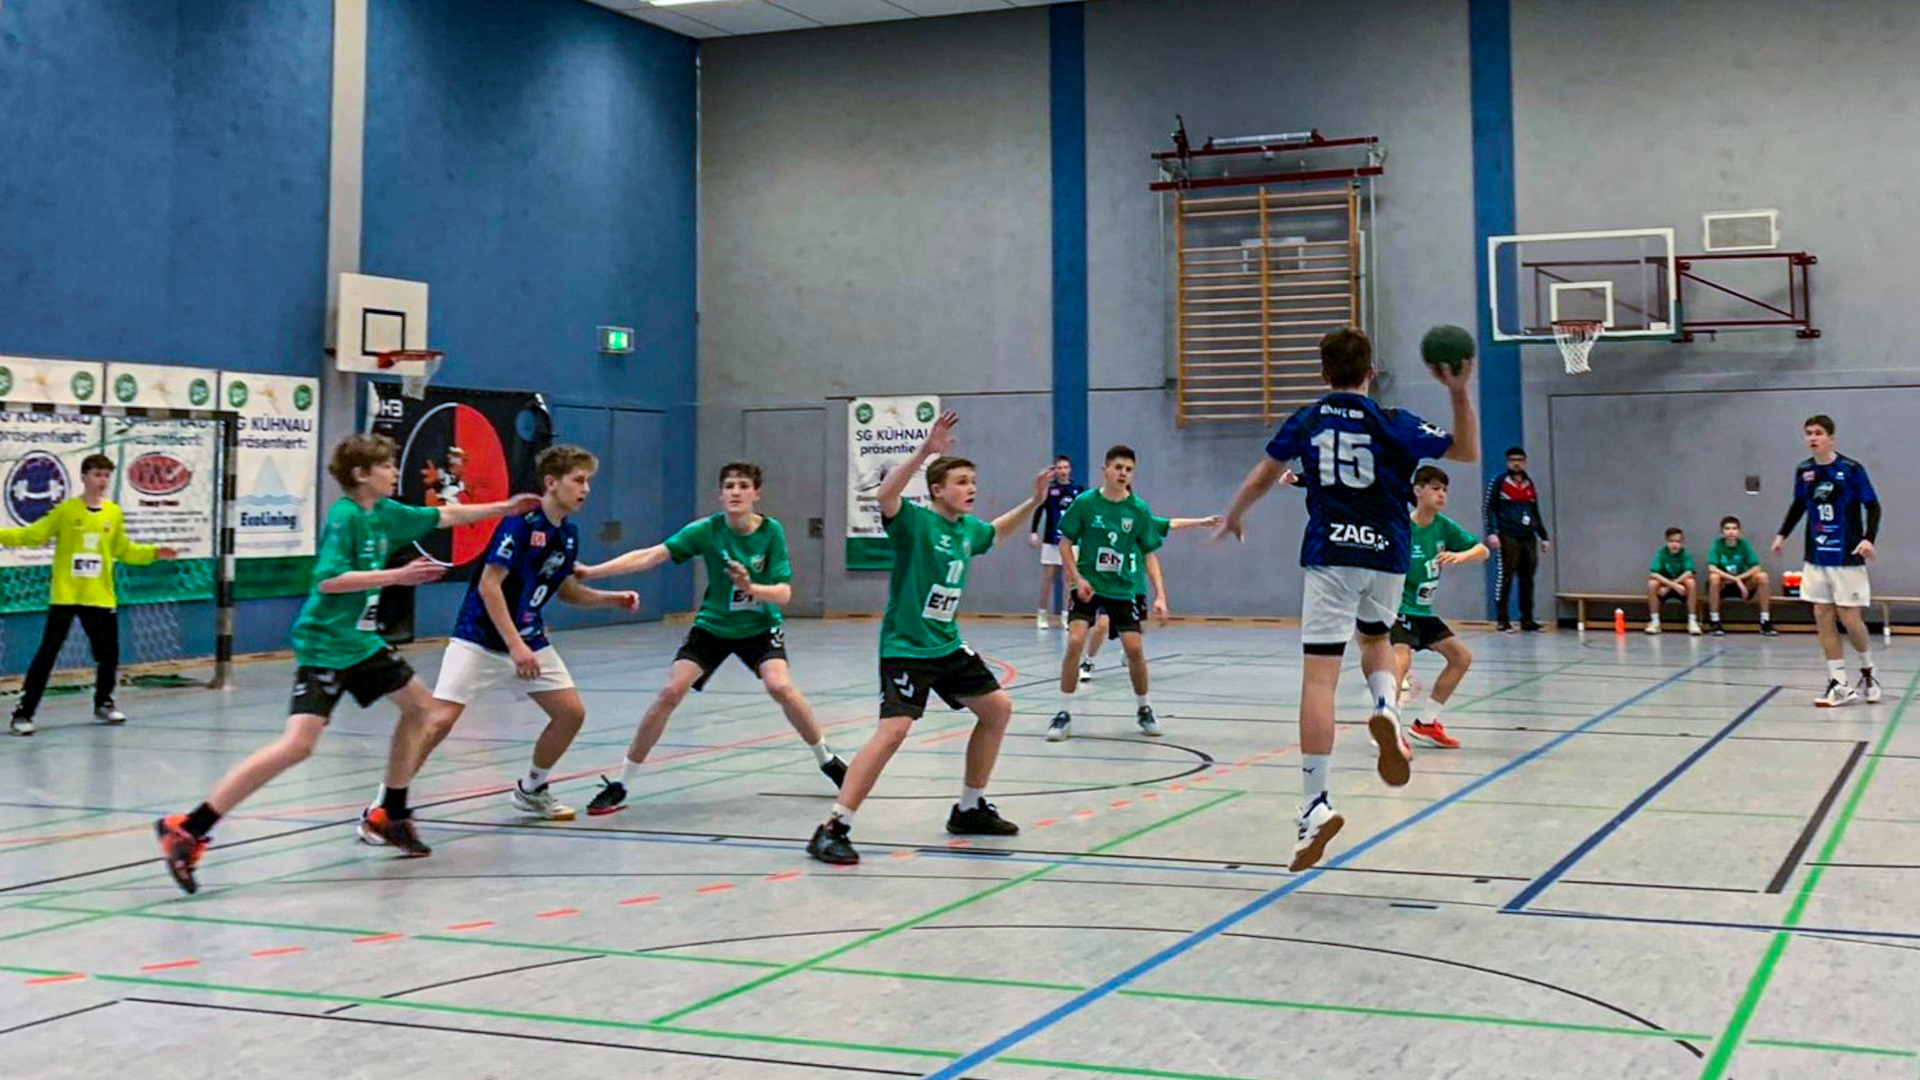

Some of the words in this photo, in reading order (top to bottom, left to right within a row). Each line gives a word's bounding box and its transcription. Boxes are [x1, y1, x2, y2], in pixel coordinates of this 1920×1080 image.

[251, 413, 312, 432] KÜHNAU
[238, 434, 308, 449] räsentiert:
[856, 429, 873, 441] SG
[860, 442, 916, 457] präsentie
[1311, 428, 1376, 489] 15
[240, 511, 297, 529] EcoLining
[1817, 503, 1835, 521] 19
[1329, 522, 1376, 545] ZAG
[946, 560, 964, 584] 11
[529, 584, 549, 608] 9
